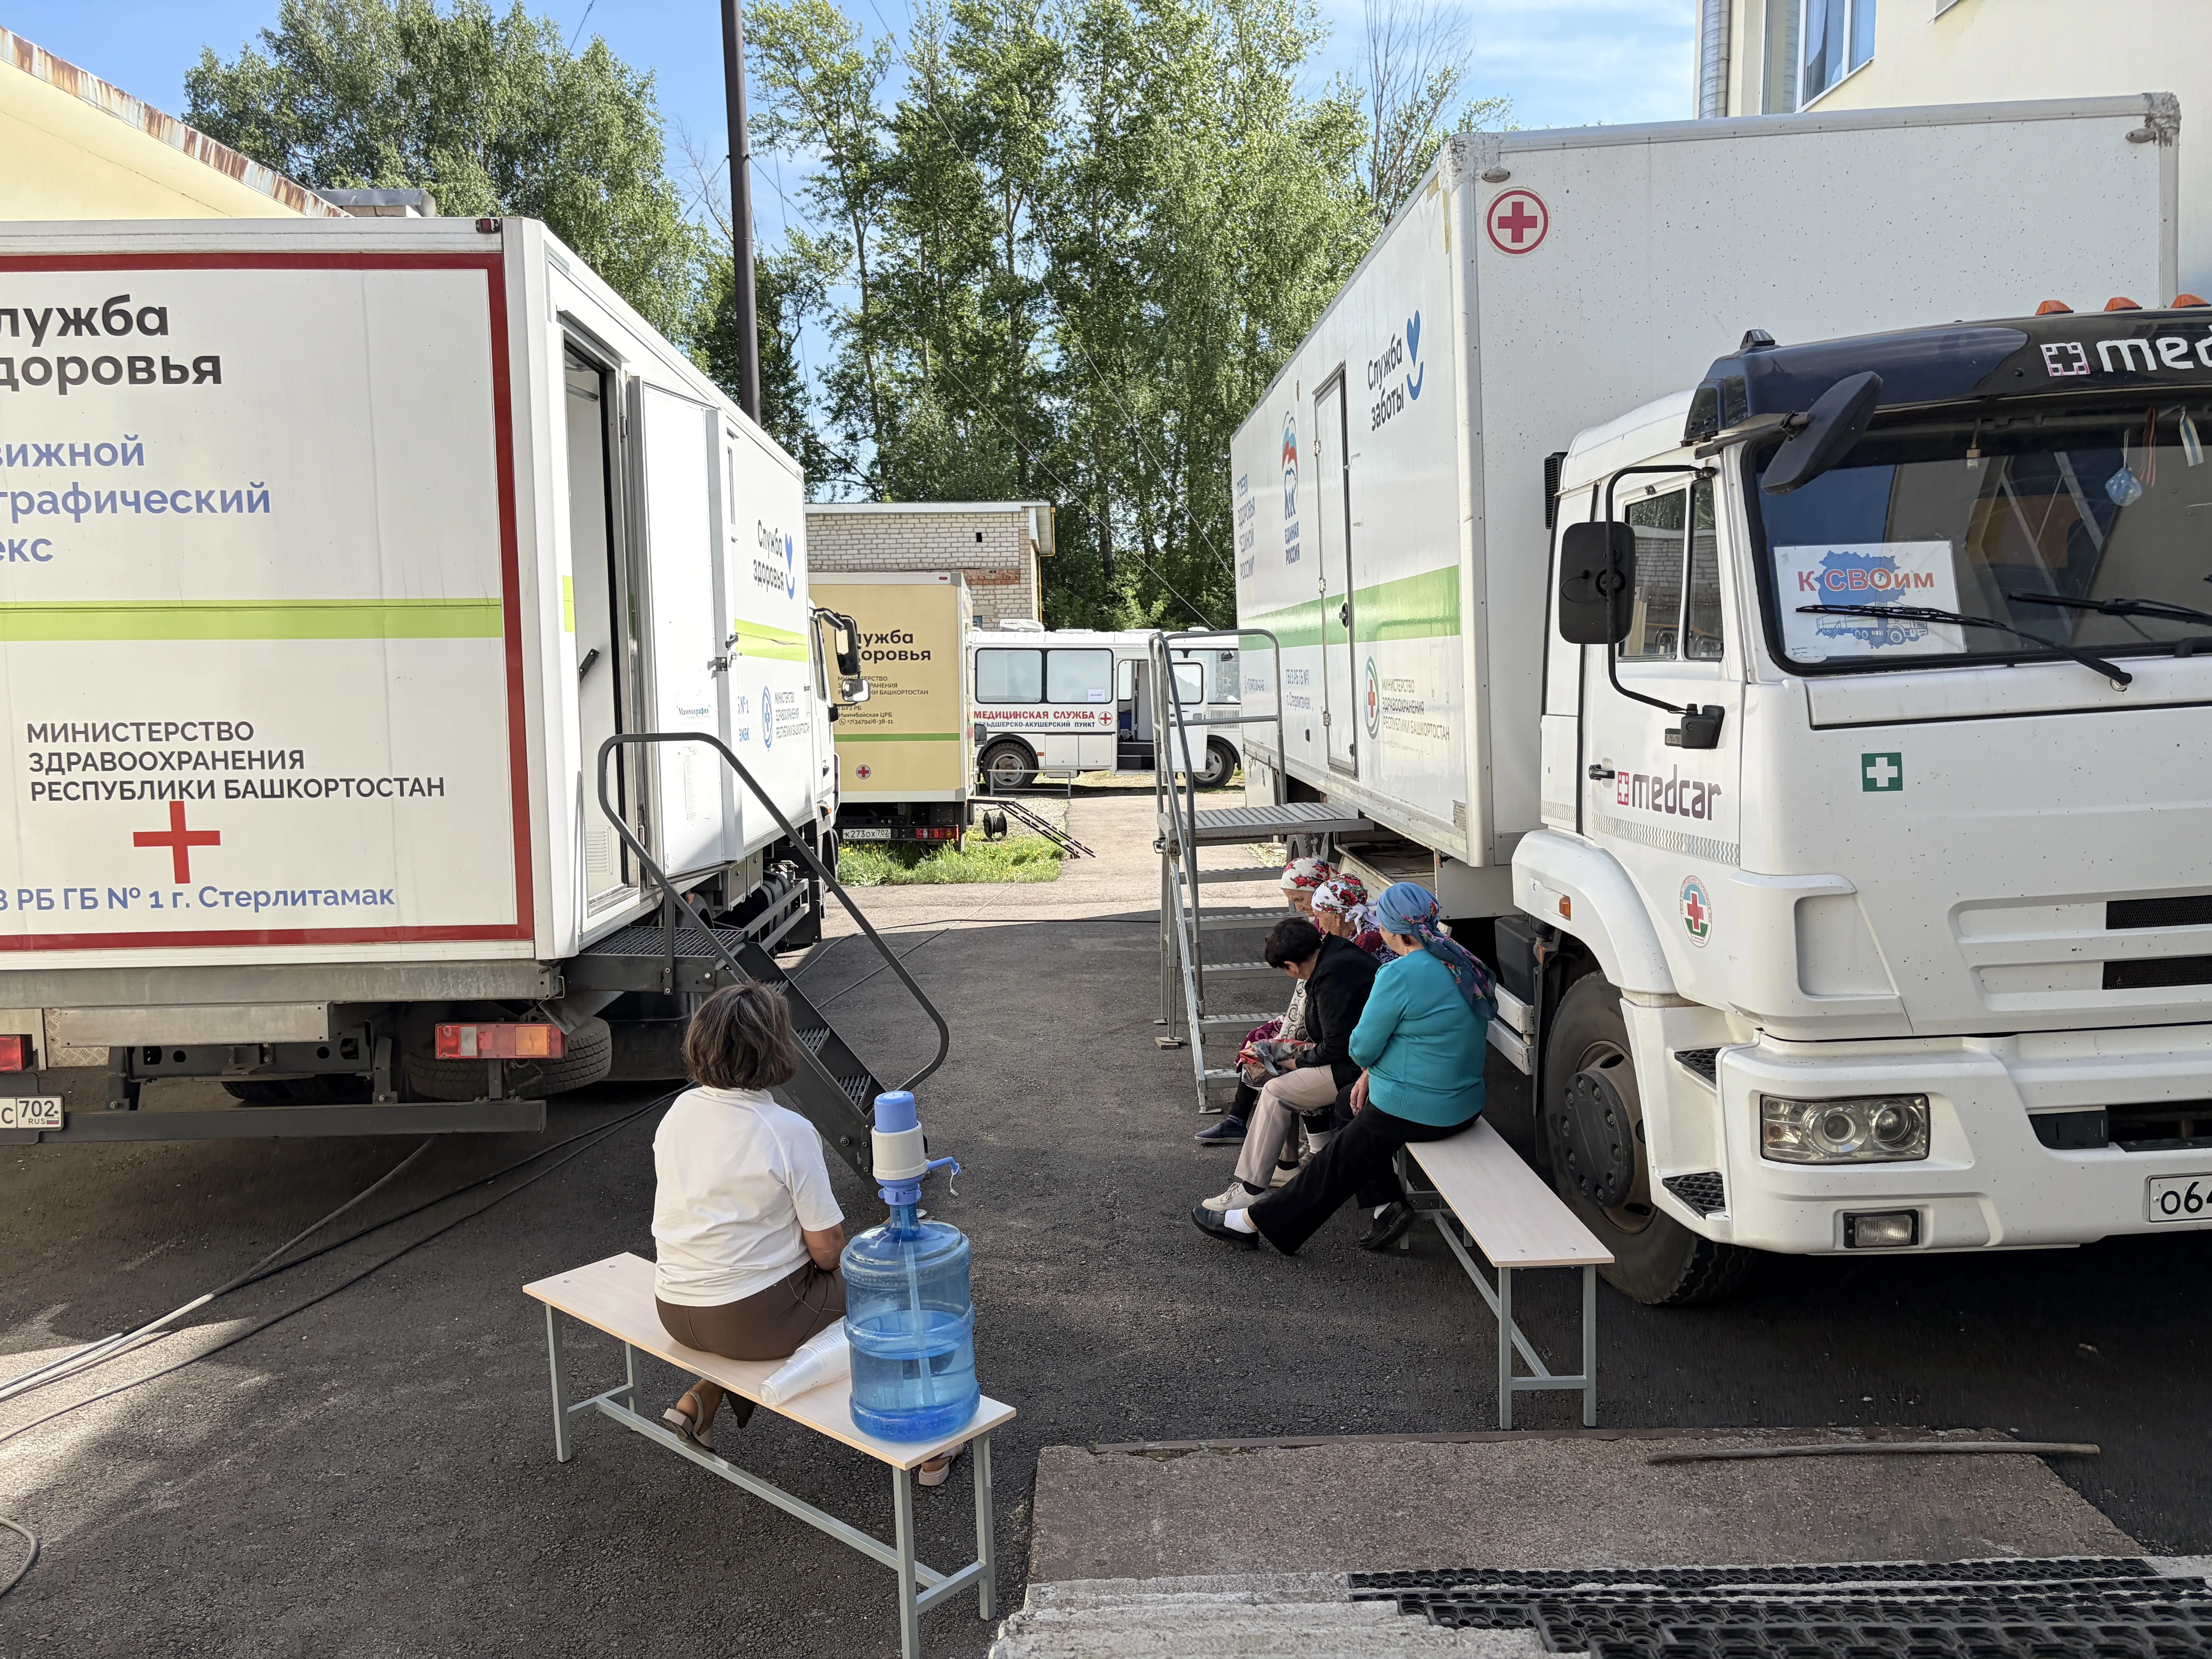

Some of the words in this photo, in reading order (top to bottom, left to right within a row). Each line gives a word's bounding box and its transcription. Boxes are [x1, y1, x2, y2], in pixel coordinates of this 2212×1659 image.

[1368, 333, 1403, 391] Служба
[1371, 382, 1404, 432] заботы
[0, 434, 144, 467] ижной
[757, 519, 783, 559] Служба
[1285, 520, 1300, 546] ЕДИНАЯ
[0, 538, 53, 562] кс
[1285, 542, 1300, 566] РОССИЯ
[753, 559, 784, 592] здоровья
[1798, 570, 1816, 592] К
[1824, 567, 1934, 591] СВОим
[859, 650, 931, 664] оровья
[1382, 678, 1415, 694] МИНИСТЕРСТВО
[974, 711, 1049, 720] МЕДИЦИНСКАЯ
[1053, 711, 1095, 719] СЛУЖБА
[1382, 697, 1424, 715] ЗДРАВООХРАНЕНИЯ
[27, 721, 254, 743] МИНИСТЕРСТВО
[1383, 716, 1410, 733] РЕСПУБЛИКИ
[1411, 720, 1449, 741] БАШКОРТОСТАН
[29, 750, 304, 776] ЗДРАВООХРАНЕНИЯ
[31, 780, 215, 802] РЕСПУБЛИКИ
[224, 777, 445, 799] БАШКОРТОСТАН
[1632, 764, 1722, 821] medcar
[17, 888, 55, 910] РБ
[64, 888, 99, 910] ГБ
[108, 887, 141, 909] №
[149, 891, 164, 908] 1
[172, 892, 190, 908] г.
[199, 886, 395, 913] Стерлитамак
[19, 1100, 54, 1118] 702
